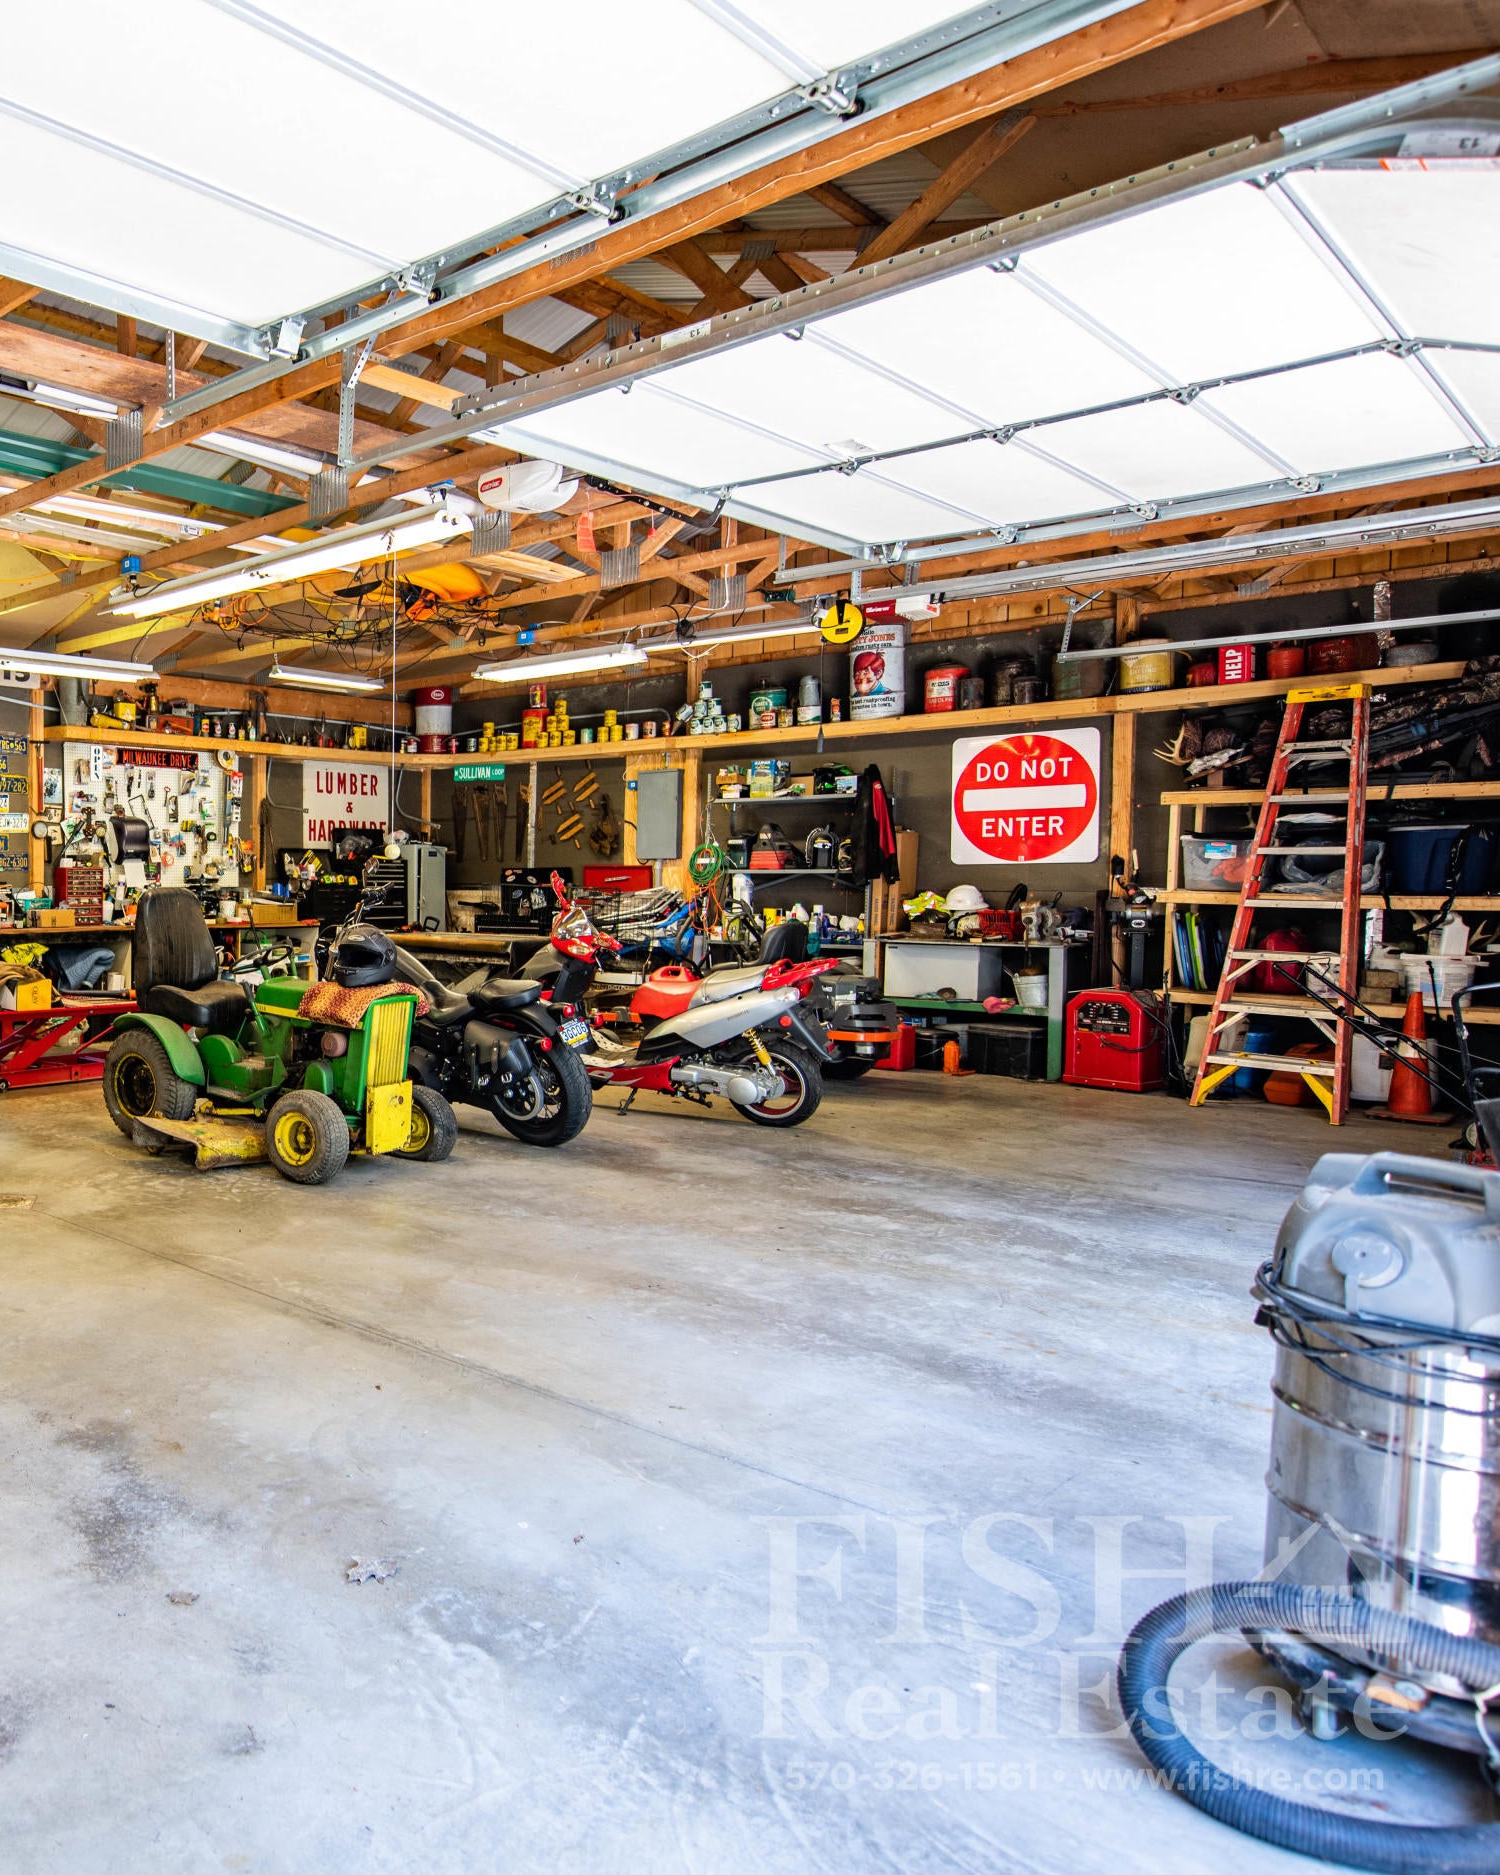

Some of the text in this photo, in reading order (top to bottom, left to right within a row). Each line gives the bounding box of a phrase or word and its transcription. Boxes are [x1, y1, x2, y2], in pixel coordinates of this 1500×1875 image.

[868, 633, 895, 643] JONES
[1224, 649, 1243, 680] HELP
[122, 750, 192, 768] MILWAUKEE DRIVE
[458, 766, 491, 780] SULLIVAN
[976, 757, 1073, 783] DO NOT
[316, 770, 379, 797] LUMBER
[346, 801, 353, 813] &
[981, 815, 1064, 838] ENTER
